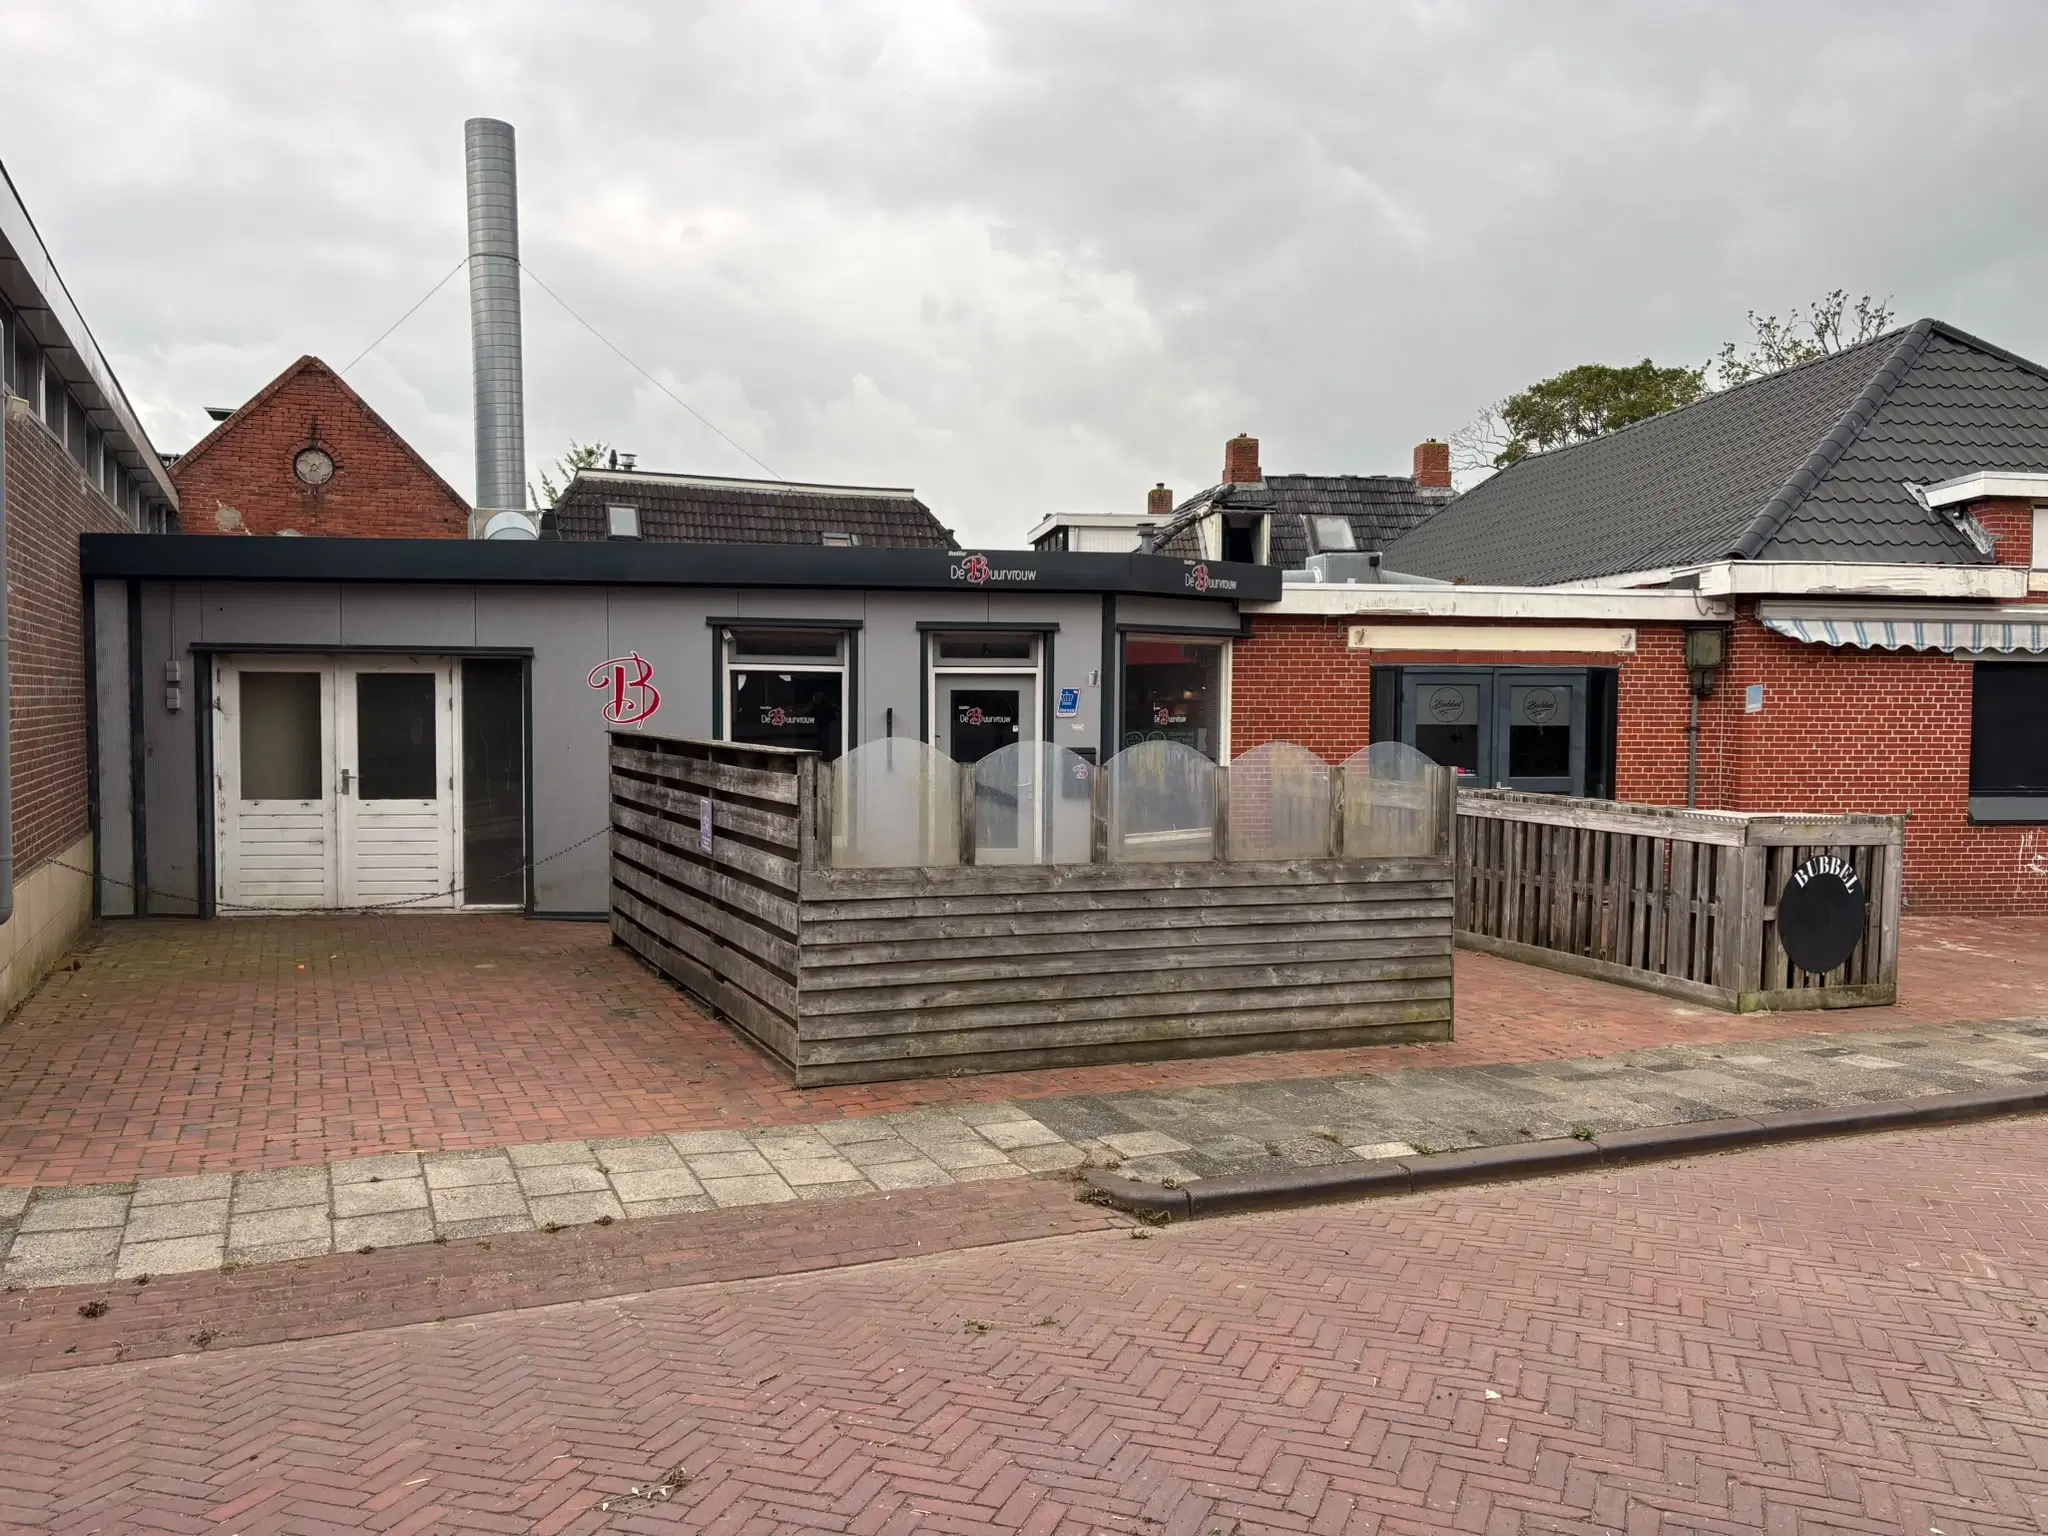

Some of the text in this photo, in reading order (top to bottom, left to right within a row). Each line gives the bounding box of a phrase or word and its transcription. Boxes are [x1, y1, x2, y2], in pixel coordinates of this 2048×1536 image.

[950, 553, 1036, 585] De Buurvrouw
[1185, 573, 1194, 587] De
[587, 650, 661, 730] B
[761, 714, 771, 724] De
[959, 714, 969, 723] De
[1794, 856, 1858, 894] BUBBEL
